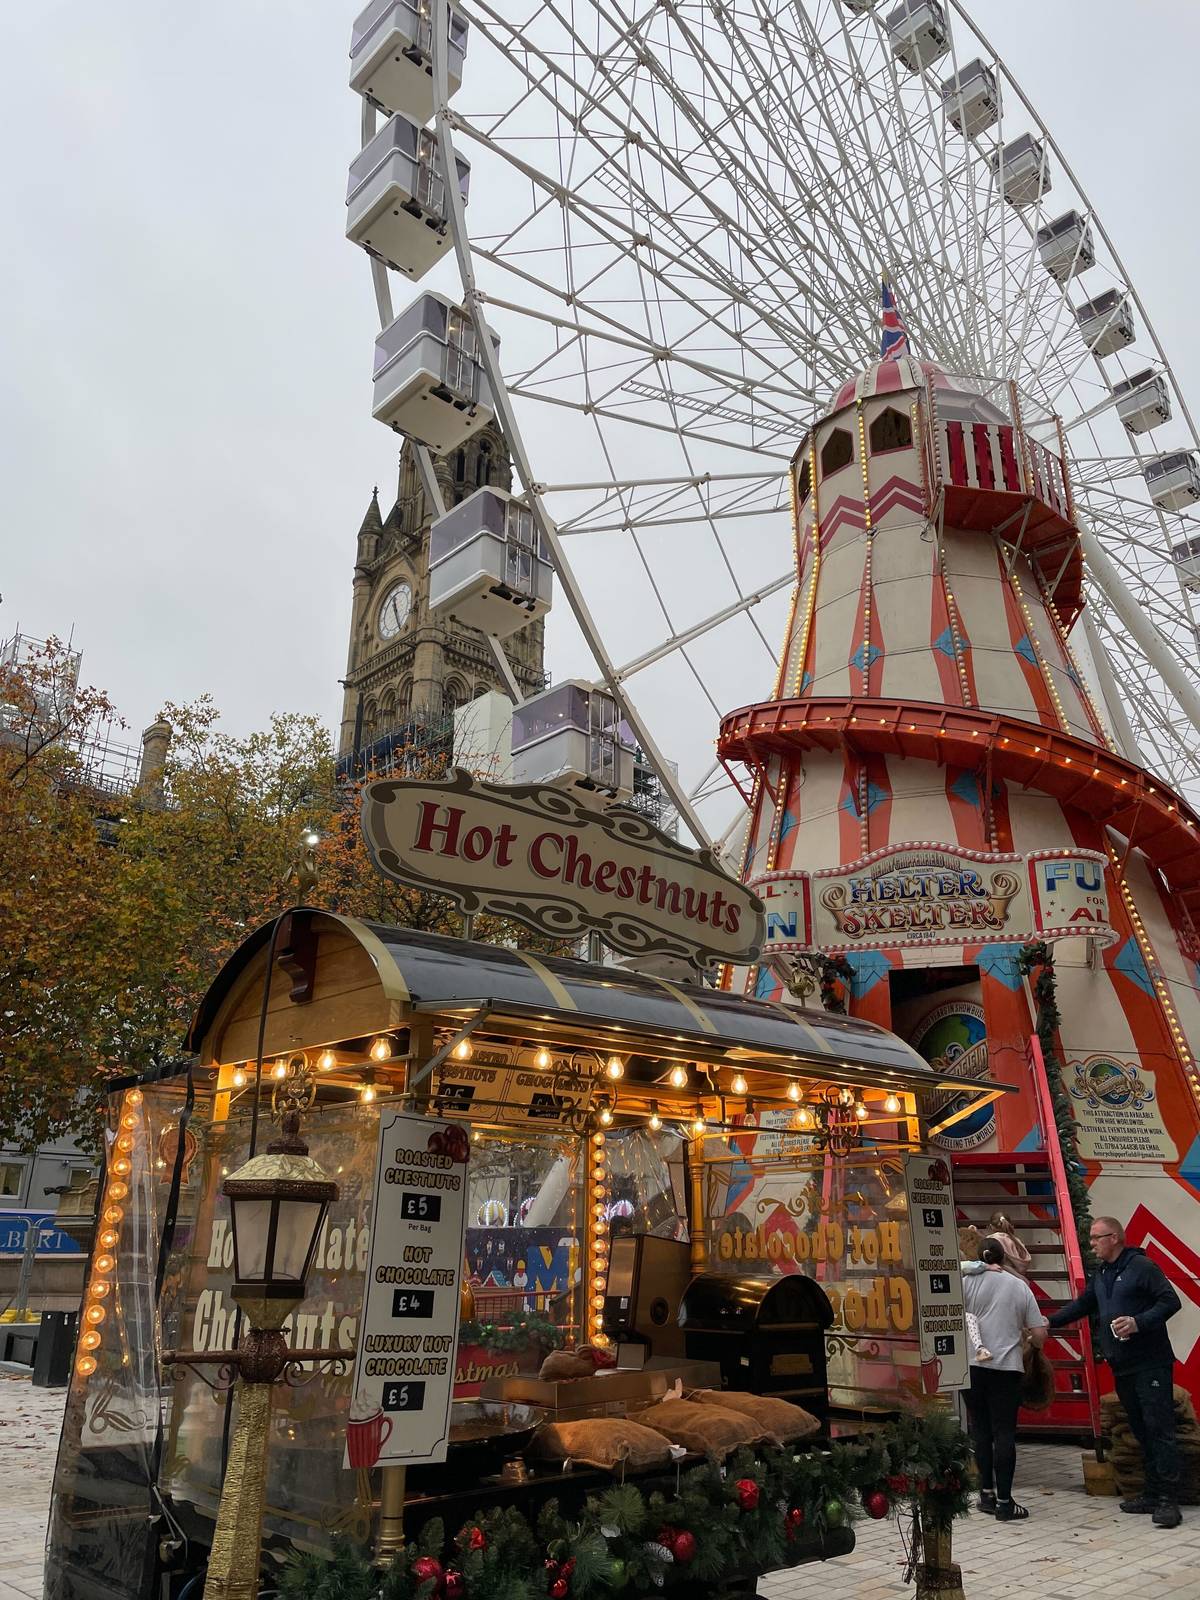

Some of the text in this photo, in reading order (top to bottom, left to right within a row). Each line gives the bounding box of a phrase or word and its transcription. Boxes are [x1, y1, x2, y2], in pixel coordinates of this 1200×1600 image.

[413, 800, 742, 935] Hot Chestnuts
[850, 870, 988, 905] HELTER
[842, 898, 1002, 938] SKELTER
[396, 1148, 454, 1170] ROASTED
[384, 1168, 461, 1191] CHESTNUTS
[407, 1196, 428, 1216] £5
[925, 1210, 936, 1225] £5
[408, 1222, 432, 1233] Per Bag
[403, 1245, 433, 1263] HOT
[929, 1244, 945, 1257] HOT
[918, 1259, 958, 1271] CHOCOLATE
[375, 1266, 455, 1286] CHOCOLATE
[932, 1278, 944, 1290] £4
[398, 1294, 421, 1311] £4
[921, 1303, 963, 1318] LUXURY HOT
[923, 1319, 963, 1333] CHOCOLATE
[365, 1334, 453, 1353] LUXURY HOT
[937, 1337, 948, 1352] £5
[365, 1357, 449, 1376] CHOCOLATE
[388, 1384, 409, 1407] £5
